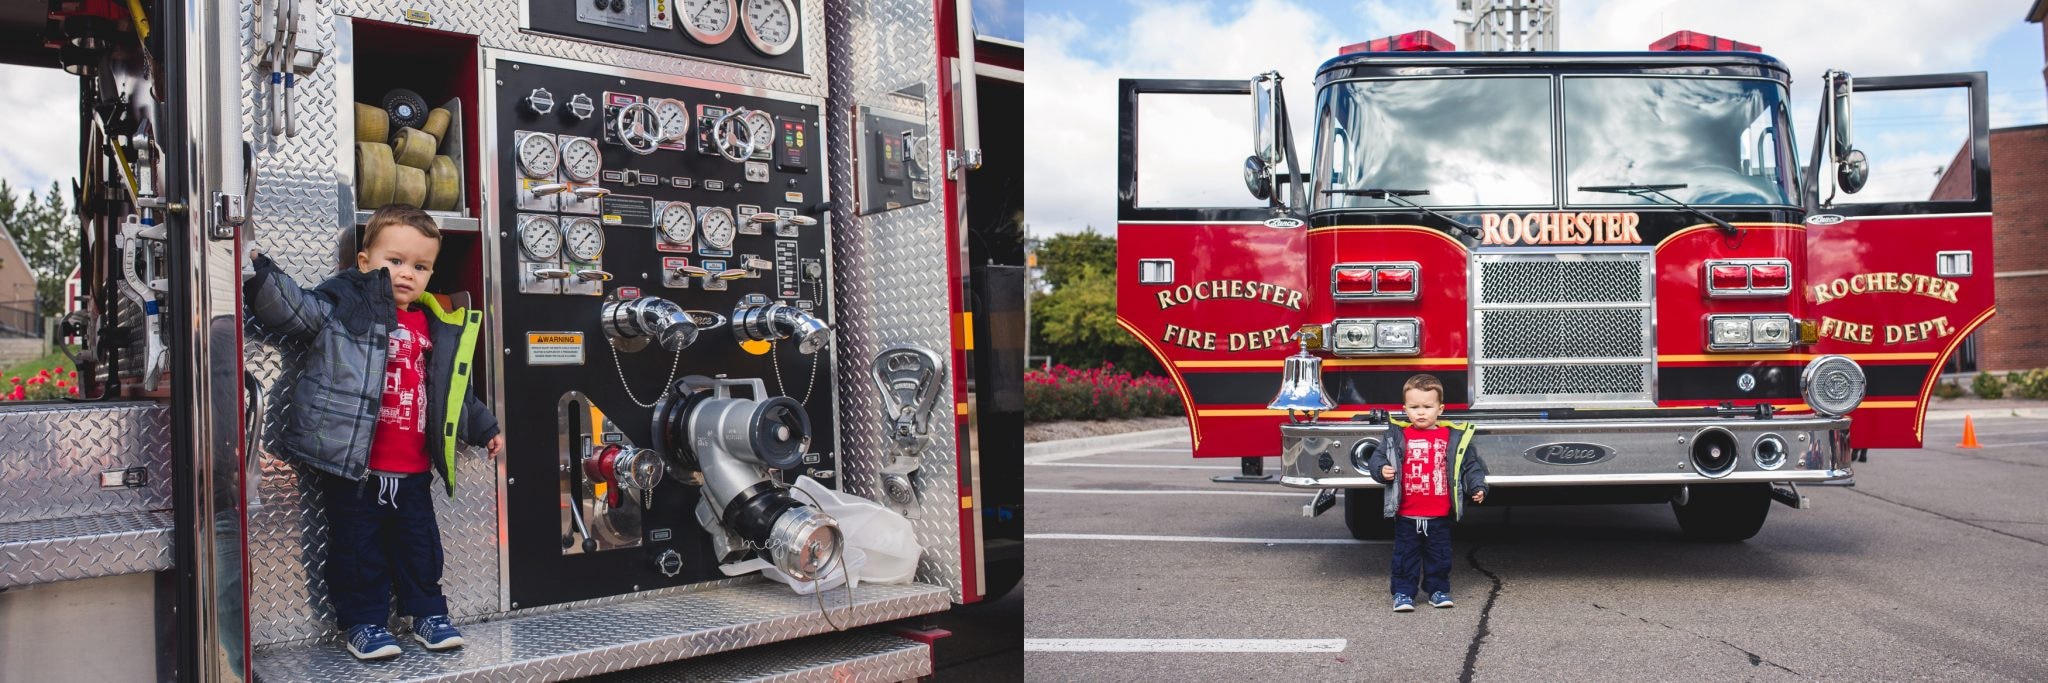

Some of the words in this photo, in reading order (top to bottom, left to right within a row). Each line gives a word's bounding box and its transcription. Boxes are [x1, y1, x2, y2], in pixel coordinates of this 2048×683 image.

[1481, 212, 1642, 245] ROCHESTER
[1156, 280, 1302, 311] ROCHESTER
[1814, 272, 1960, 305] ROCHESTER
[1162, 324, 1216, 350] FIRE
[1820, 316, 1873, 344] FIRE
[1884, 316, 1956, 345] DEPT.
[1544, 444, 1596, 461] Pierce
